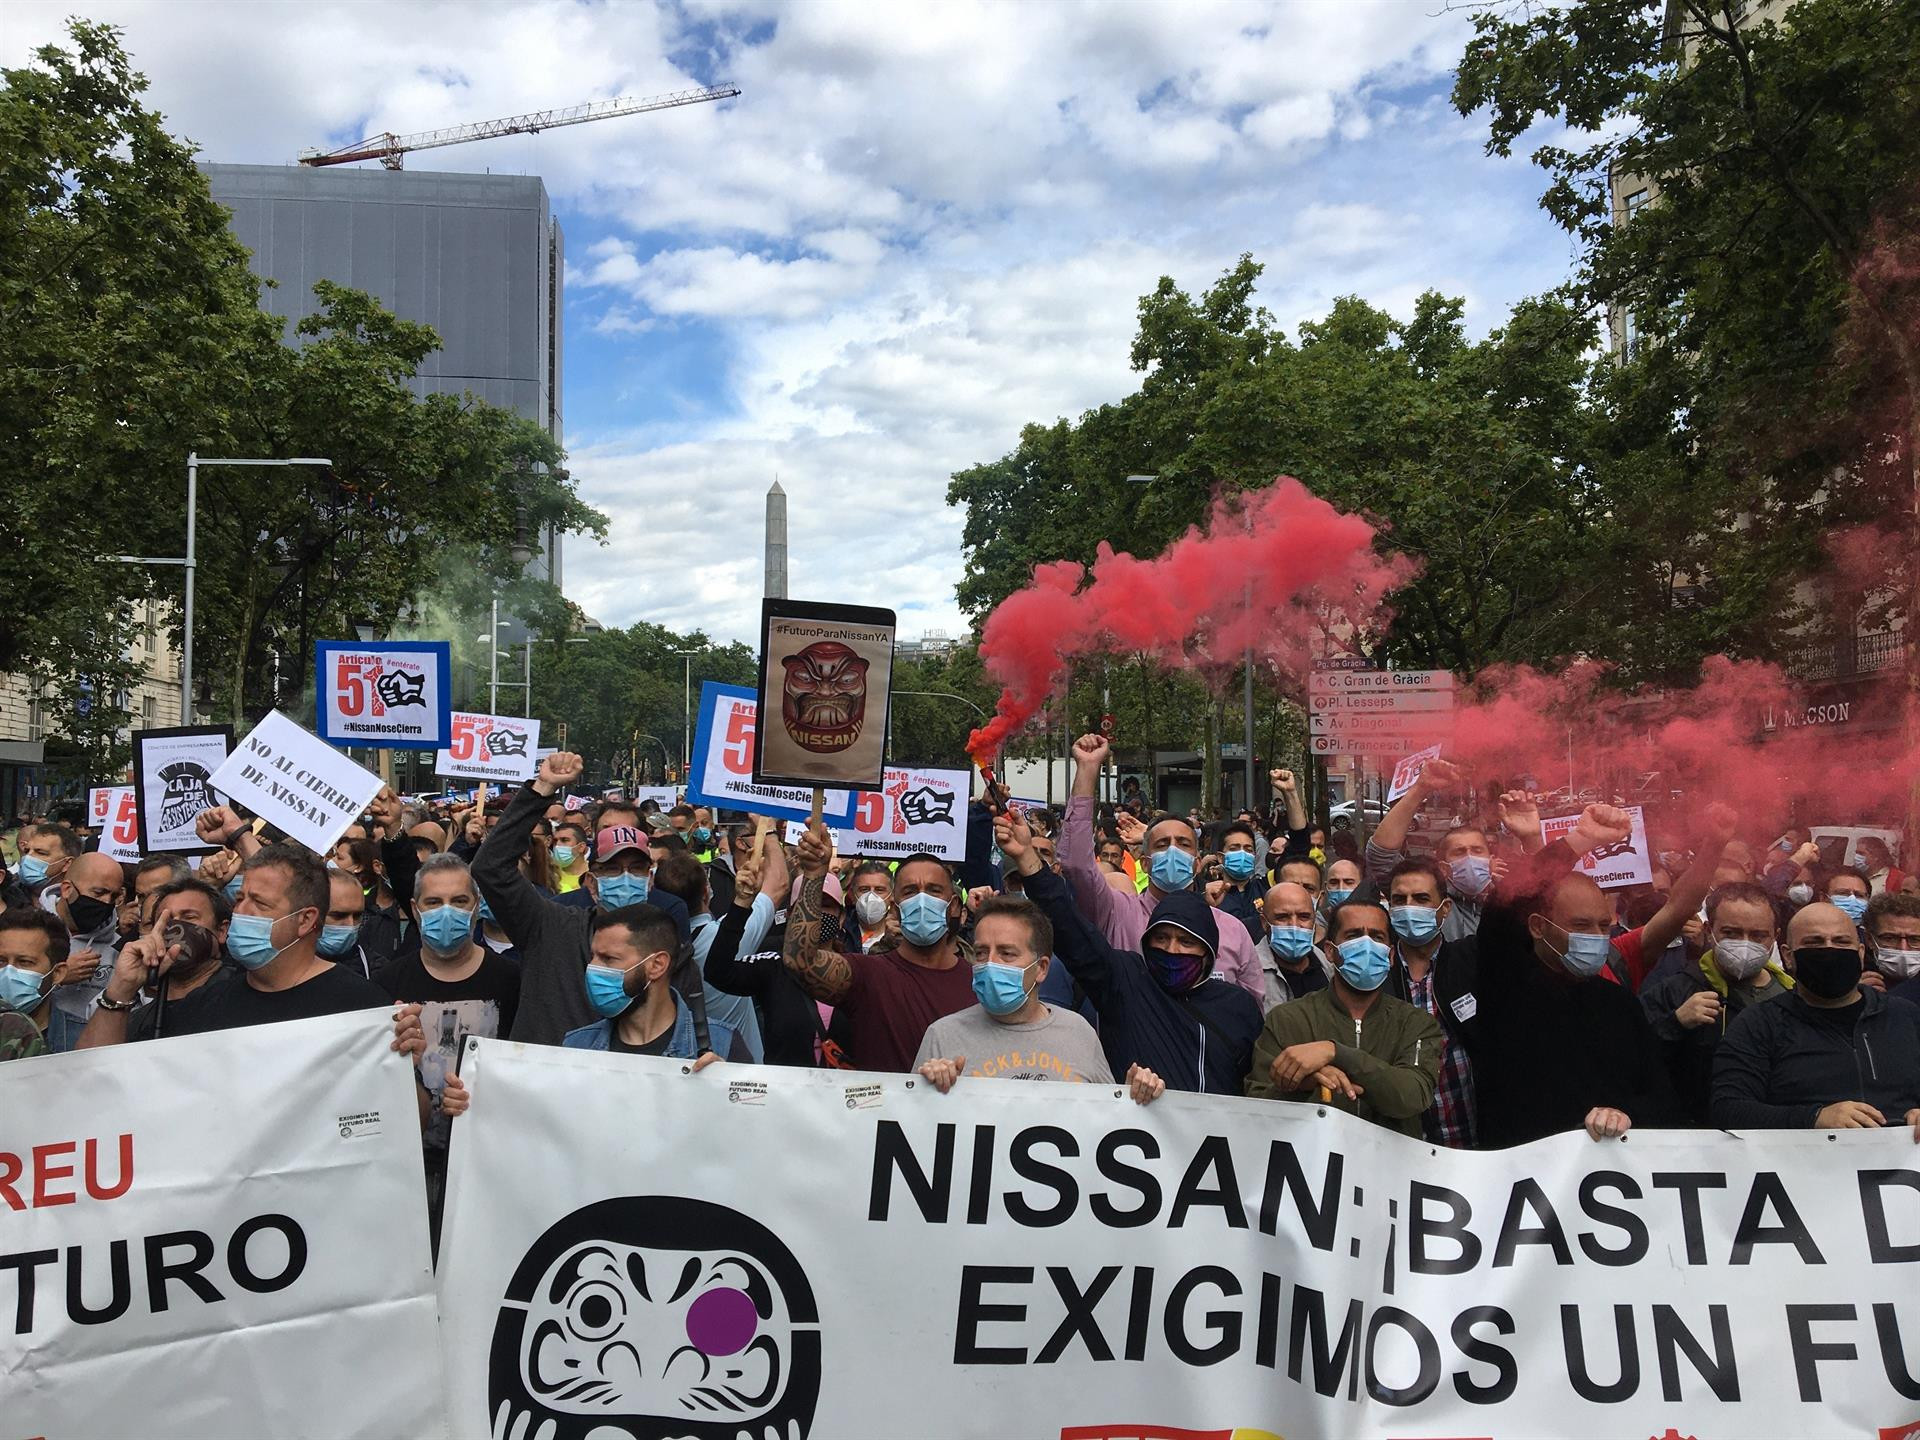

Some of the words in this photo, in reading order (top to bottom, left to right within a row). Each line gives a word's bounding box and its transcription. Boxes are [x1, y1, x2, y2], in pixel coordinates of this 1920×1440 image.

[776, 625, 888, 642] #FuturoParaNissanYA
[1331, 660, 1340, 668] de
[1329, 676, 1341, 686] C.
[1344, 676, 1371, 686] Gran
[1375, 675, 1389, 685] de
[1392, 673, 1431, 685] Gràcia
[337, 665, 384, 716] 51
[1328, 697, 1343, 708] Pl.
[1347, 697, 1395, 709] Lesseps
[343, 722, 422, 734] #NissanNoseCierra
[1329, 718, 1347, 729] Av.
[449, 721, 494, 762] 51
[790, 729, 858, 746] NISSAN
[1329, 739, 1343, 750] Pl.
[1348, 739, 1400, 750] Francesc
[244, 736, 272, 759] NO
[270, 755, 296, 776] AL
[295, 769, 361, 817] CIERRE
[451, 763, 520, 777] #NissanNoseCierra
[168, 778, 203, 792] CAJA
[912, 775, 950, 788] #entérate
[183, 791, 204, 801] DE
[239, 764, 268, 788] DE
[265, 780, 332, 828] NISSAN
[161, 799, 208, 831] RESISTENCIA
[855, 781, 909, 835] 51
[613, 827, 637, 844] IN
[856, 839, 947, 854] #NissanNoseCierra
[868, 1119, 1363, 1259] NISSAN:
[1383, 1170, 1828, 1295] ¡BASTA
[0, 1213, 308, 1335] TURO
[952, 1264, 1518, 1406] EXIGIMOS
[1560, 1304, 1741, 1404] UN
[1785, 1302, 1920, 1404] FU
